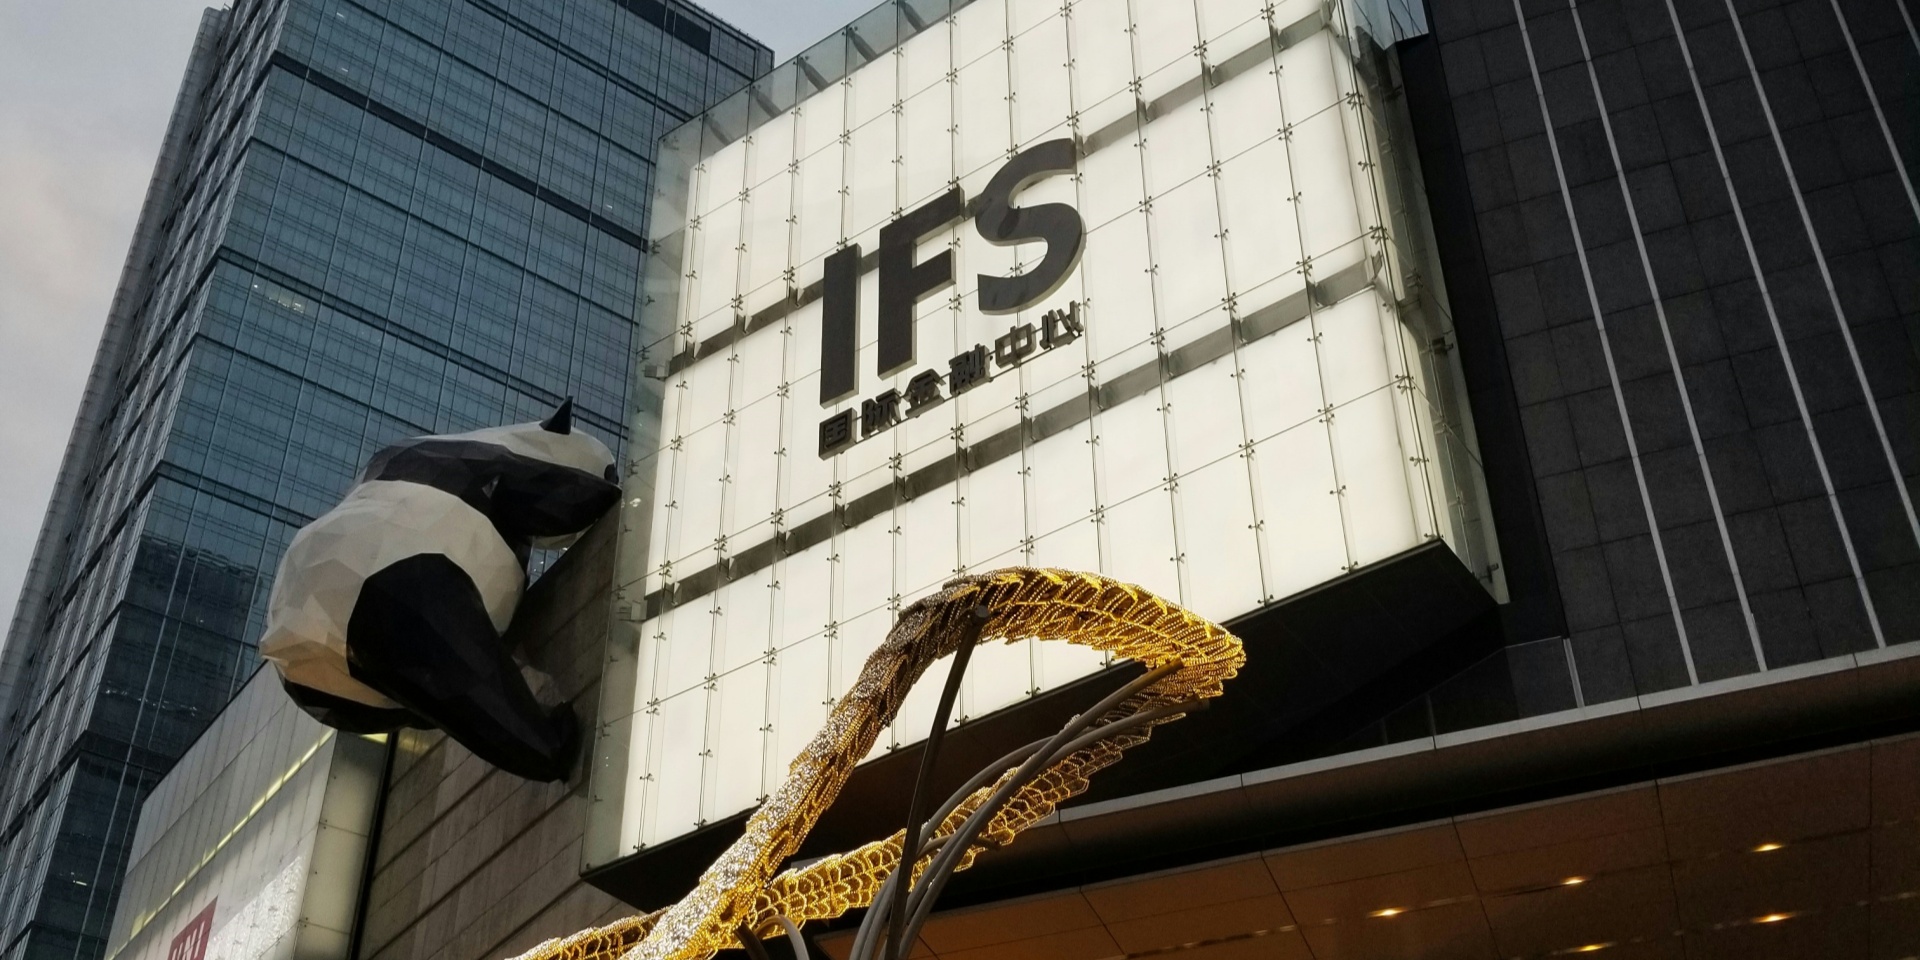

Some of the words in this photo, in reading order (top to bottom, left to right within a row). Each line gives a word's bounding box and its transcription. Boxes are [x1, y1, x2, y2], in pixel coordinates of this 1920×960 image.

[819, 300, 1083, 460] 国际金融中心
[820, 138, 1086, 408] IFS
